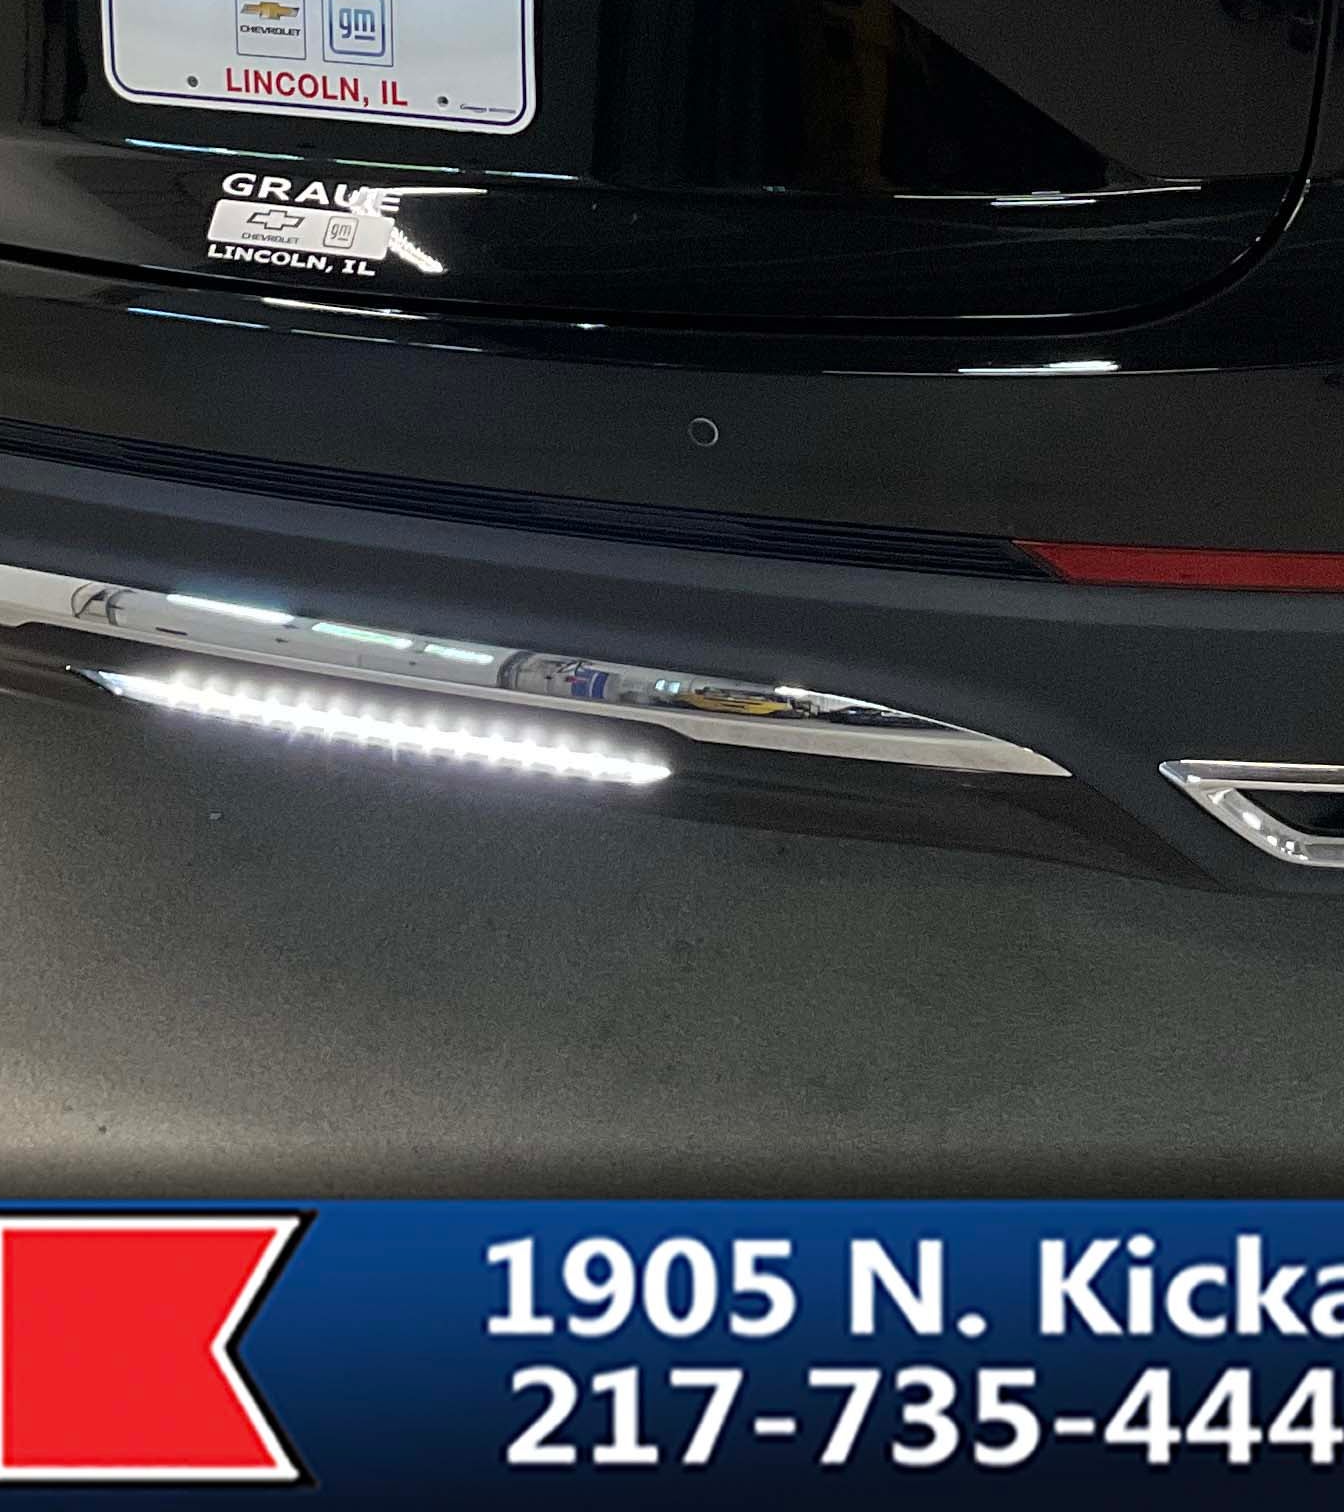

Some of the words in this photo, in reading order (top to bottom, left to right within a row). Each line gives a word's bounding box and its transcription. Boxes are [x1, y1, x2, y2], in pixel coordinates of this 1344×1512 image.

[239, 24, 301, 37] CHEVROLET
[225, 67, 370, 107] LINCOLN,
[381, 80, 408, 107] IL
[241, 231, 300, 245] CHEVROLET
[207, 242, 334, 274] LINCOLN,
[342, 259, 376, 276] IL
